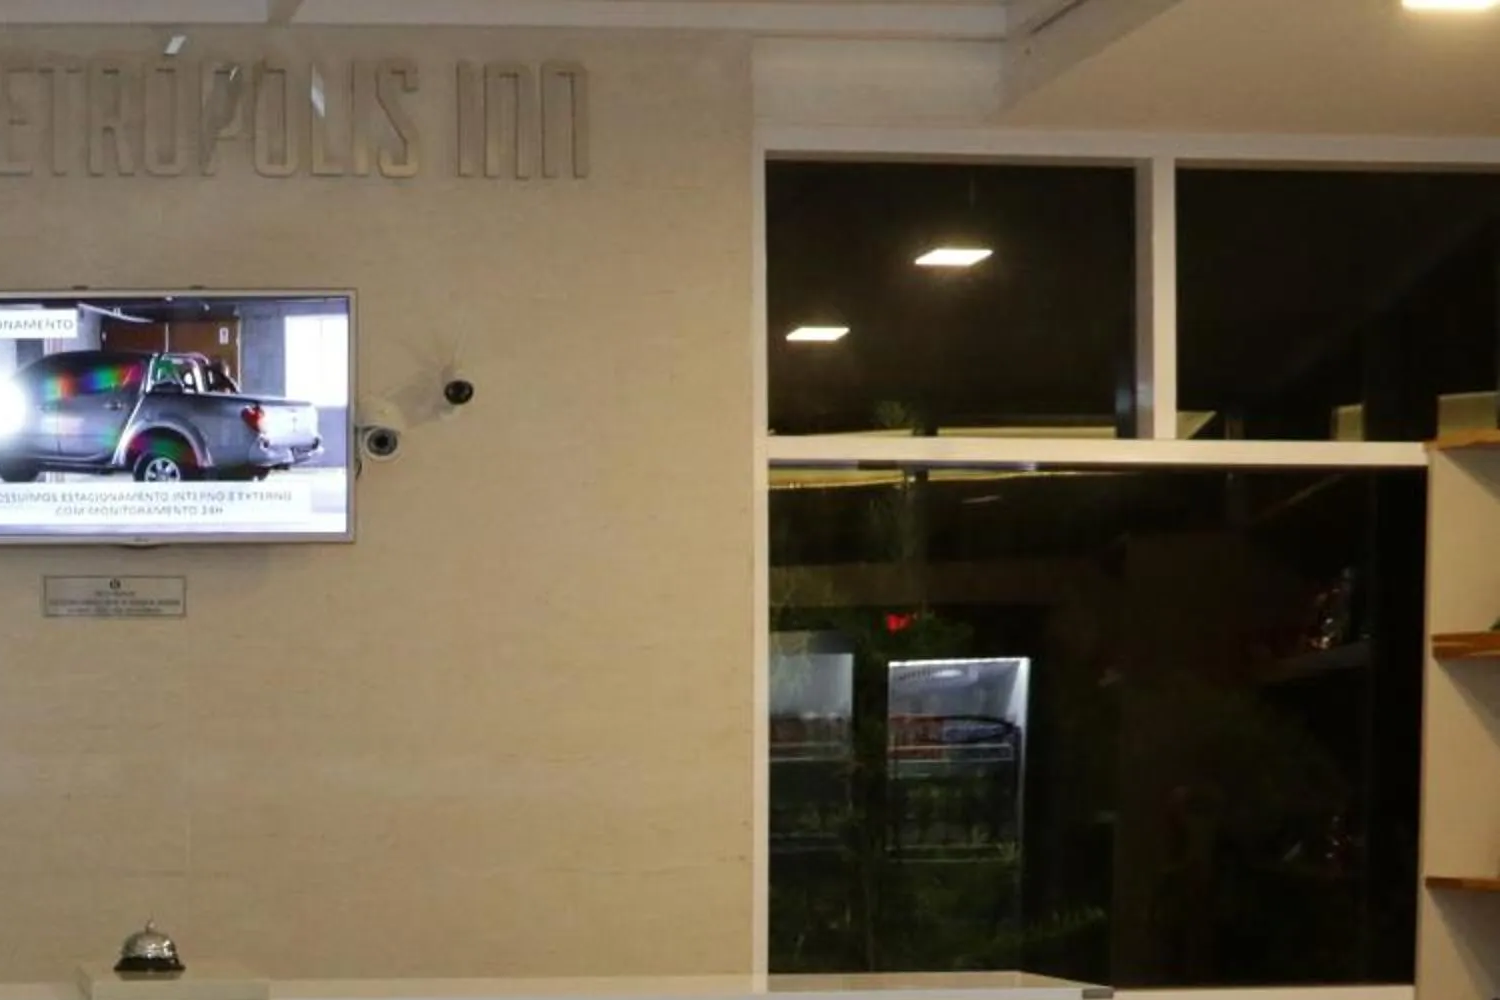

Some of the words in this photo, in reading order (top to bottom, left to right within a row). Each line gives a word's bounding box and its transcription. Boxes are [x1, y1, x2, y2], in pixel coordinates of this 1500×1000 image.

[61, 491, 169, 503] ESTACIONAMENTO
[172, 491, 225, 503] INTERNO
[238, 491, 293, 502] EXTERNO
[87, 505, 198, 517] MONITORAMENTO
